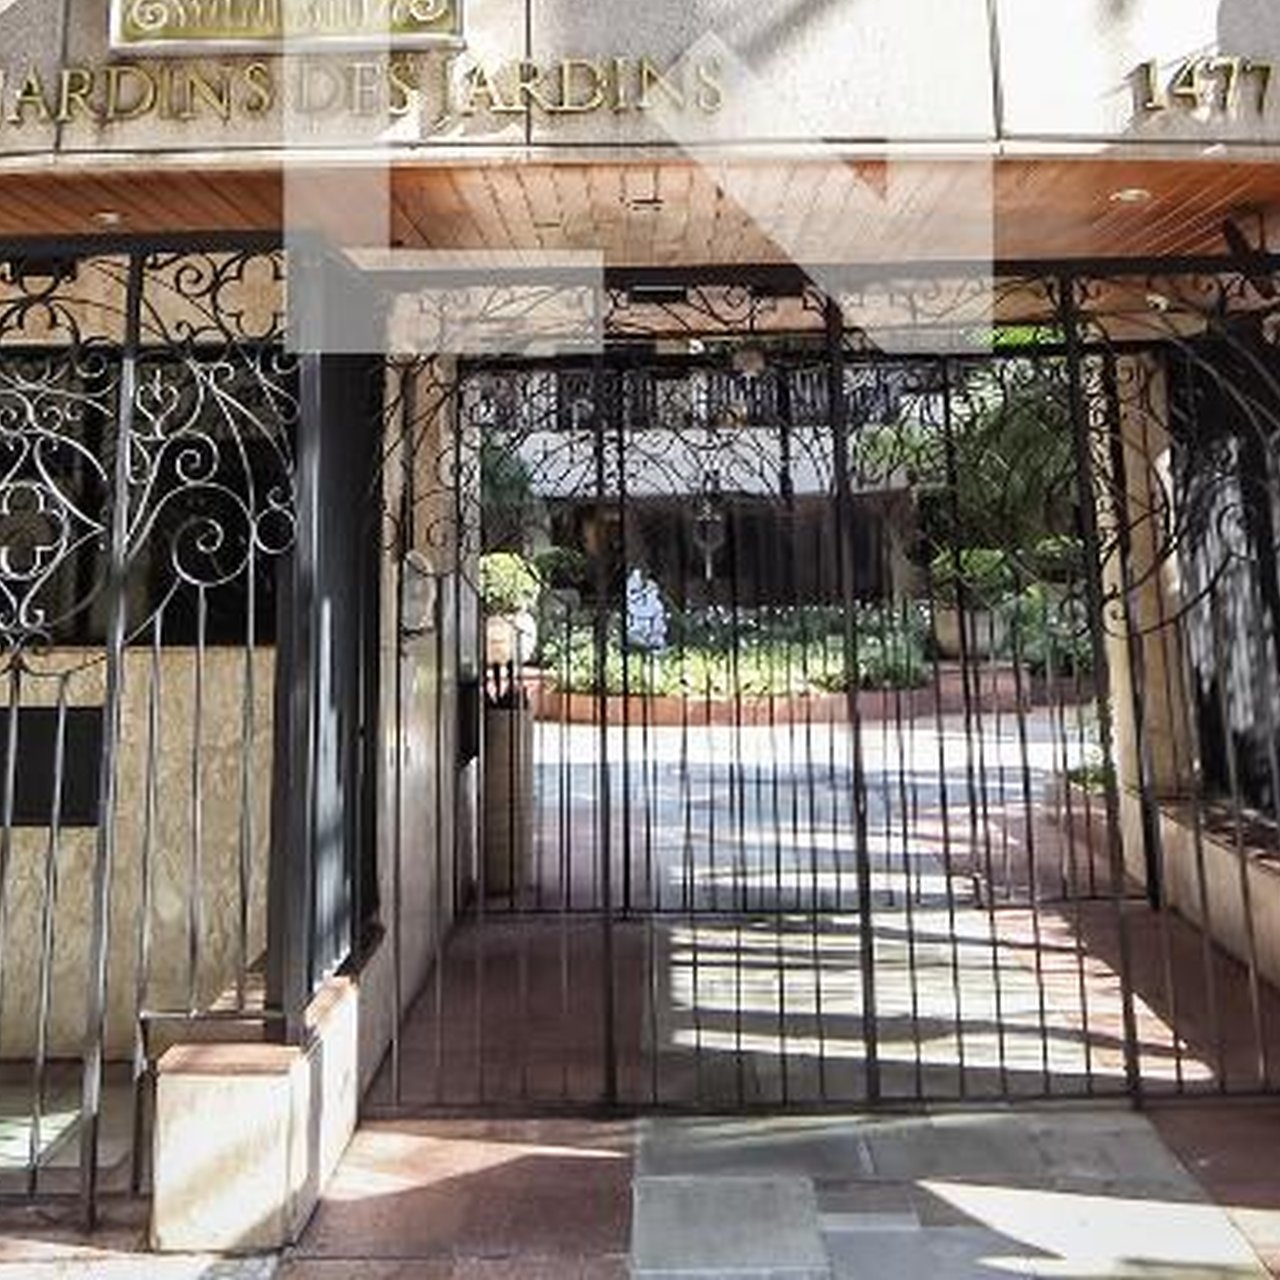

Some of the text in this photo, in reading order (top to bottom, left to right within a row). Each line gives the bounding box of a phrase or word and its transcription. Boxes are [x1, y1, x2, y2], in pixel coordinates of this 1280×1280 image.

[297, 53, 418, 117] DES
[431, 54, 725, 134] JARDINS
[1129, 56, 1275, 117] 1477
